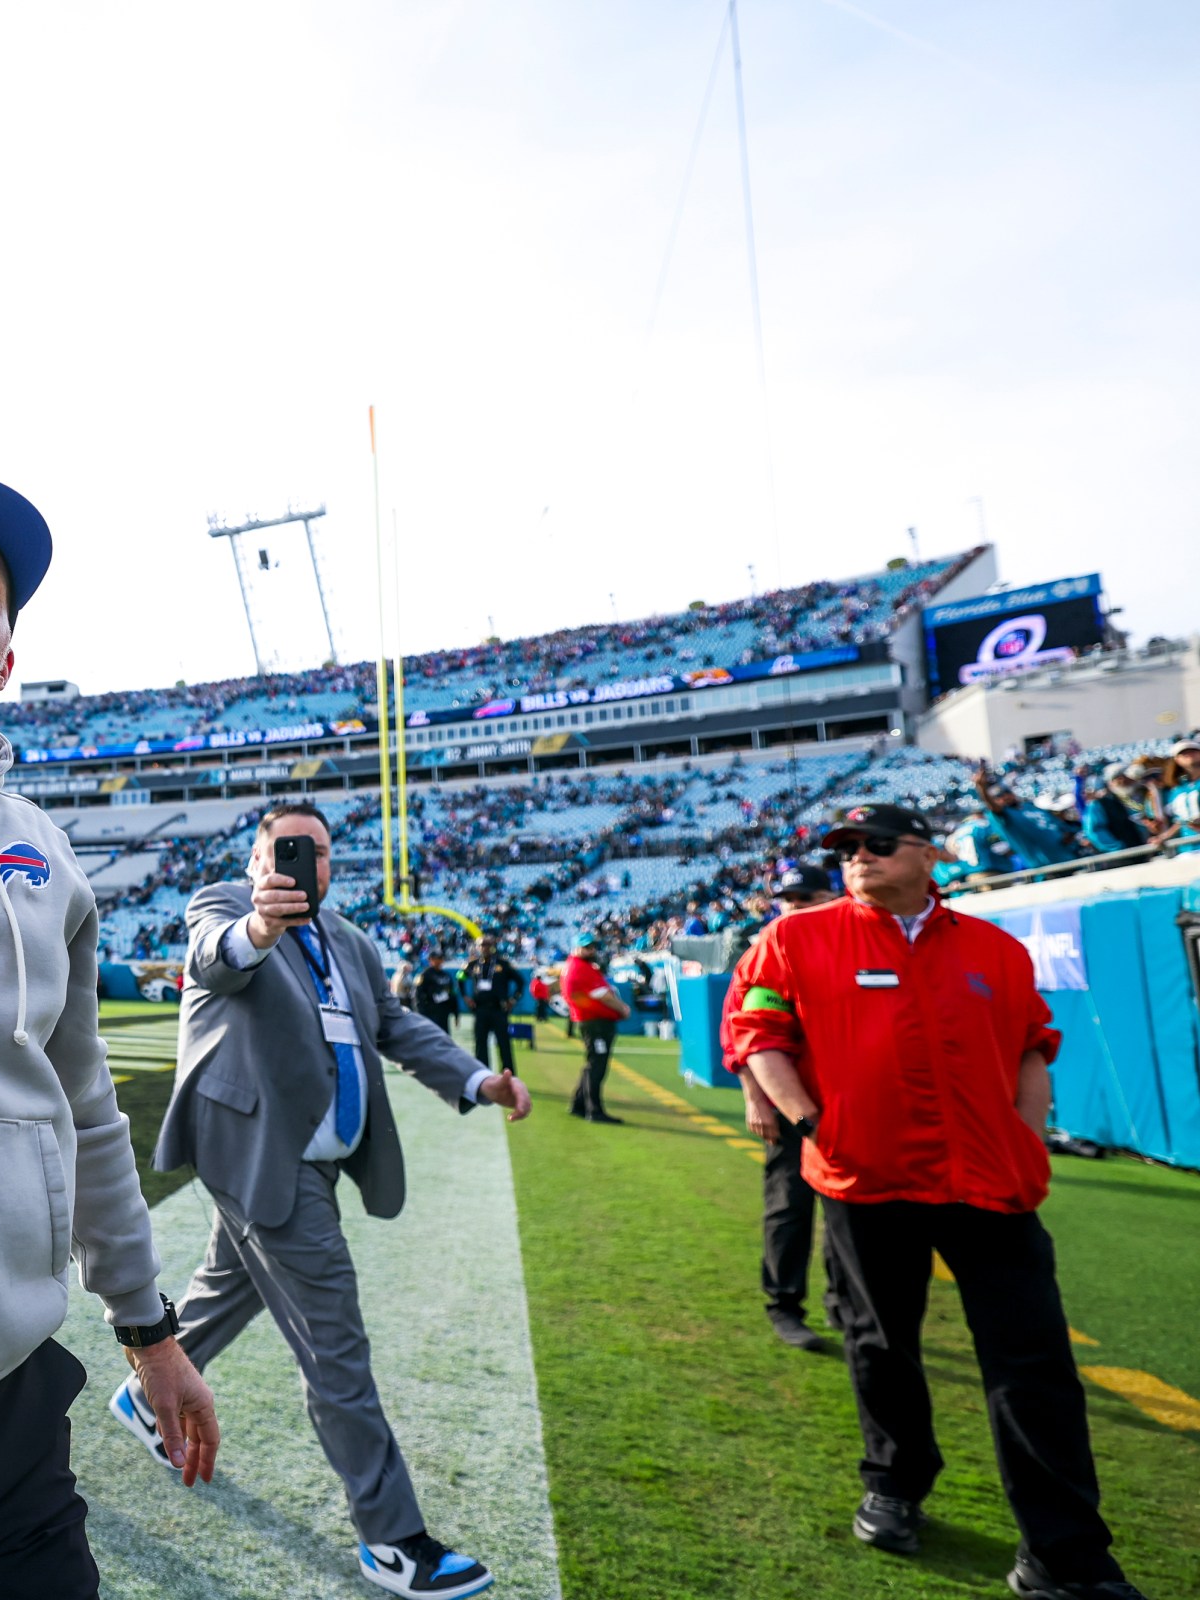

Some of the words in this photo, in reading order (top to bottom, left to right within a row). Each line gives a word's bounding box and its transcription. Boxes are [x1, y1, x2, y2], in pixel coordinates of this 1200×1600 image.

[521, 691, 568, 712] BILLS
[593, 675, 674, 702] JAGUARS
[209, 732, 245, 748] BILLS
[264, 722, 324, 743] JAGUARS
